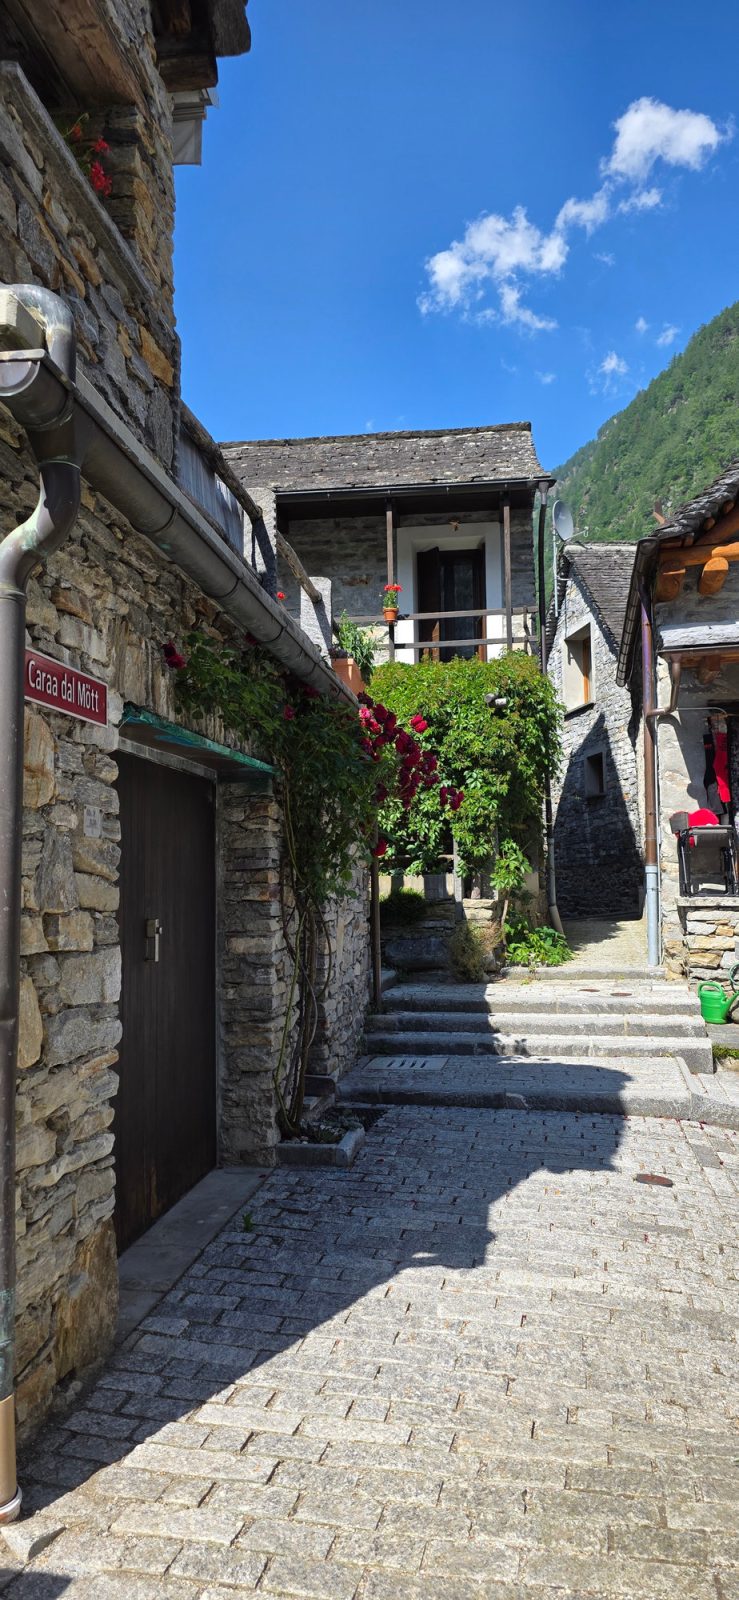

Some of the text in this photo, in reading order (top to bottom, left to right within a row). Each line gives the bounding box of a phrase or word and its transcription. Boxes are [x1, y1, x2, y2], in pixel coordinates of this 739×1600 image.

[28, 660, 99, 713] Caraa dal Mött
